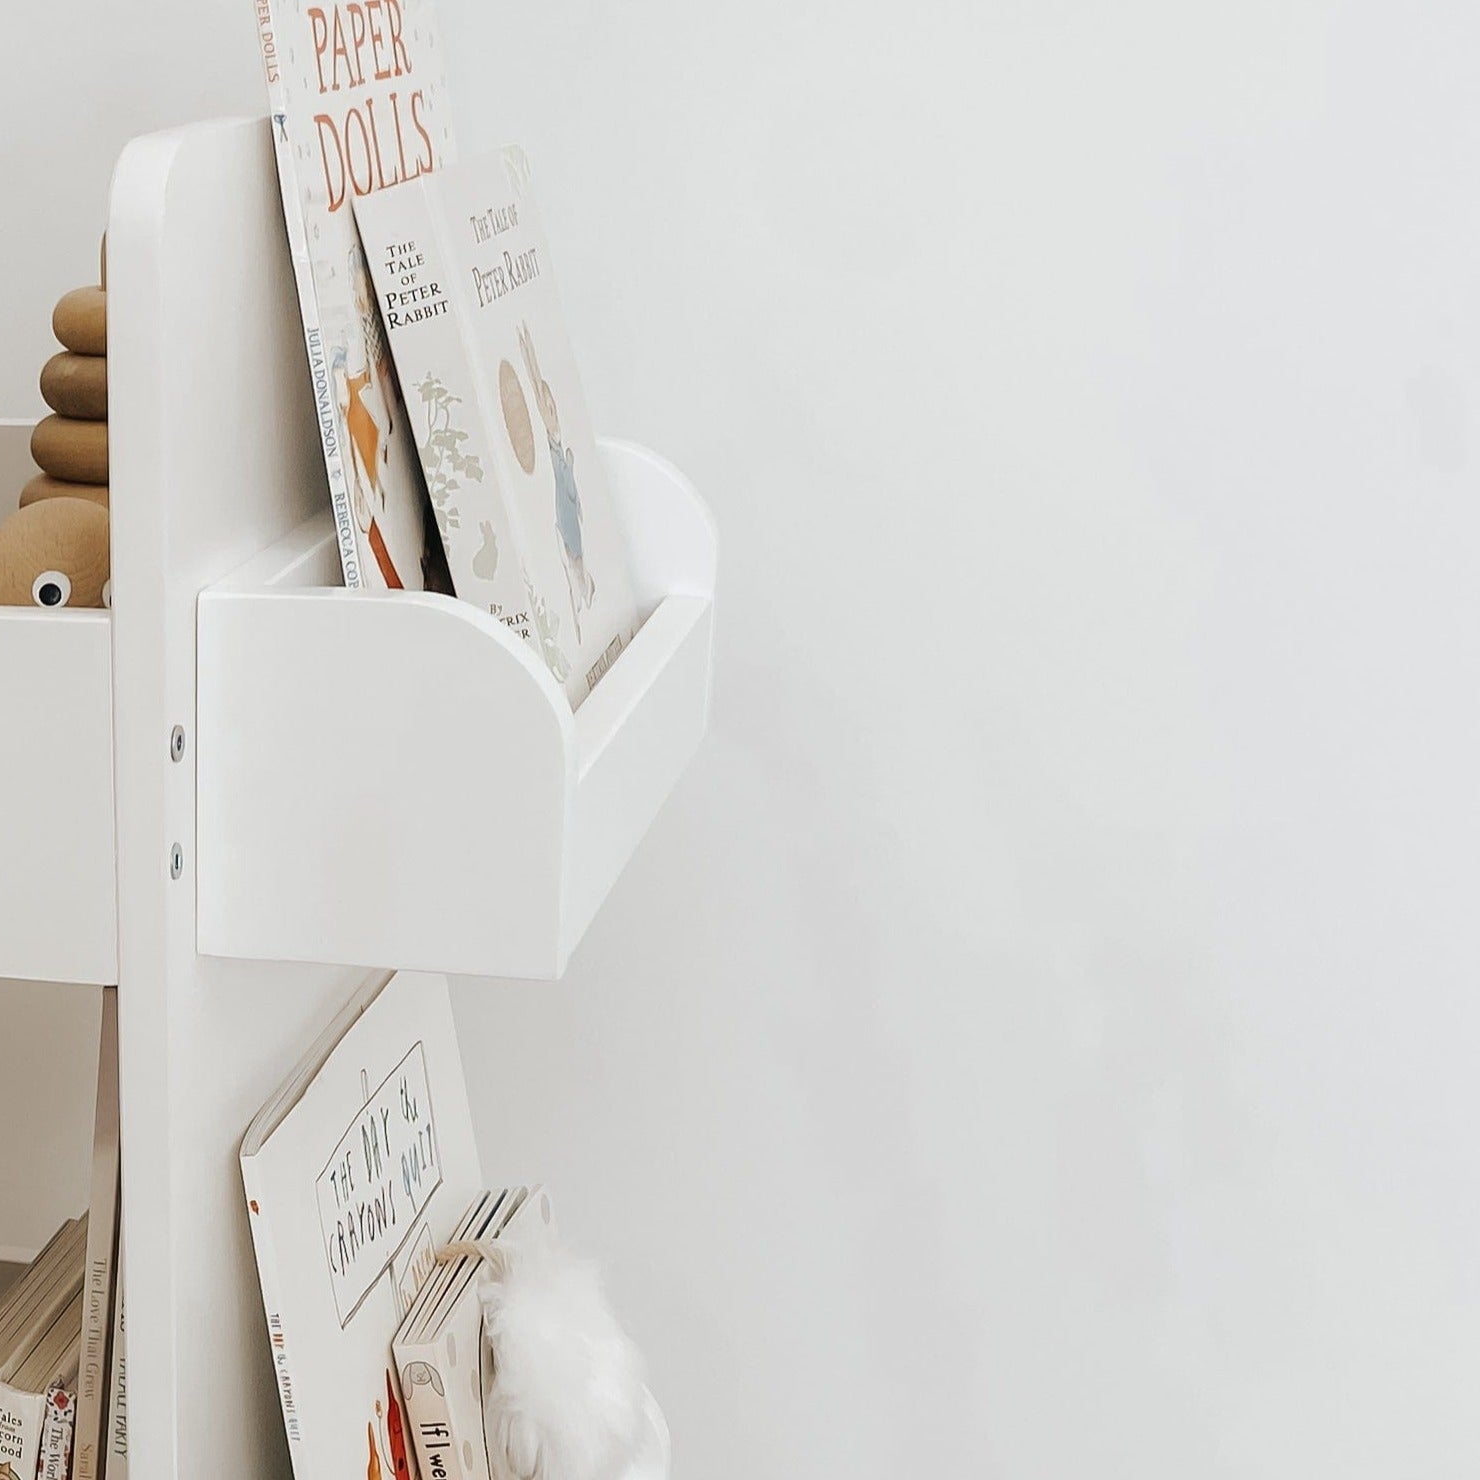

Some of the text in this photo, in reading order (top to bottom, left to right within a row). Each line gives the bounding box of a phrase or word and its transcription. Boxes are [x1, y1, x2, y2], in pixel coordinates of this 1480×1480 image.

[262, 32, 280, 84] DOLLS
[307, 0, 413, 94] PAPER
[313, 90, 434, 213] DOLLS
[385, 253, 425, 275] TALE
[386, 241, 416, 258] THE
[401, 273, 418, 286] OF
[471, 248, 541, 308] PETER RABBIT
[385, 282, 442, 310] PETER
[387, 300, 449, 330] RABBIT
[307, 328, 354, 558] JULIA DONALDSON REBECCA
[331, 1106, 390, 1209] THE DAY
[401, 1123, 434, 1215] QUIT
[330, 1180, 396, 1276] CRAYONS
[91, 1258, 107, 1287] The
[89, 1289, 105, 1324] Love
[87, 1327, 103, 1358] That
[84, 1362, 100, 1399] Grew
[50, 1427, 64, 1450] The
[420, 1422, 449, 1437] If
